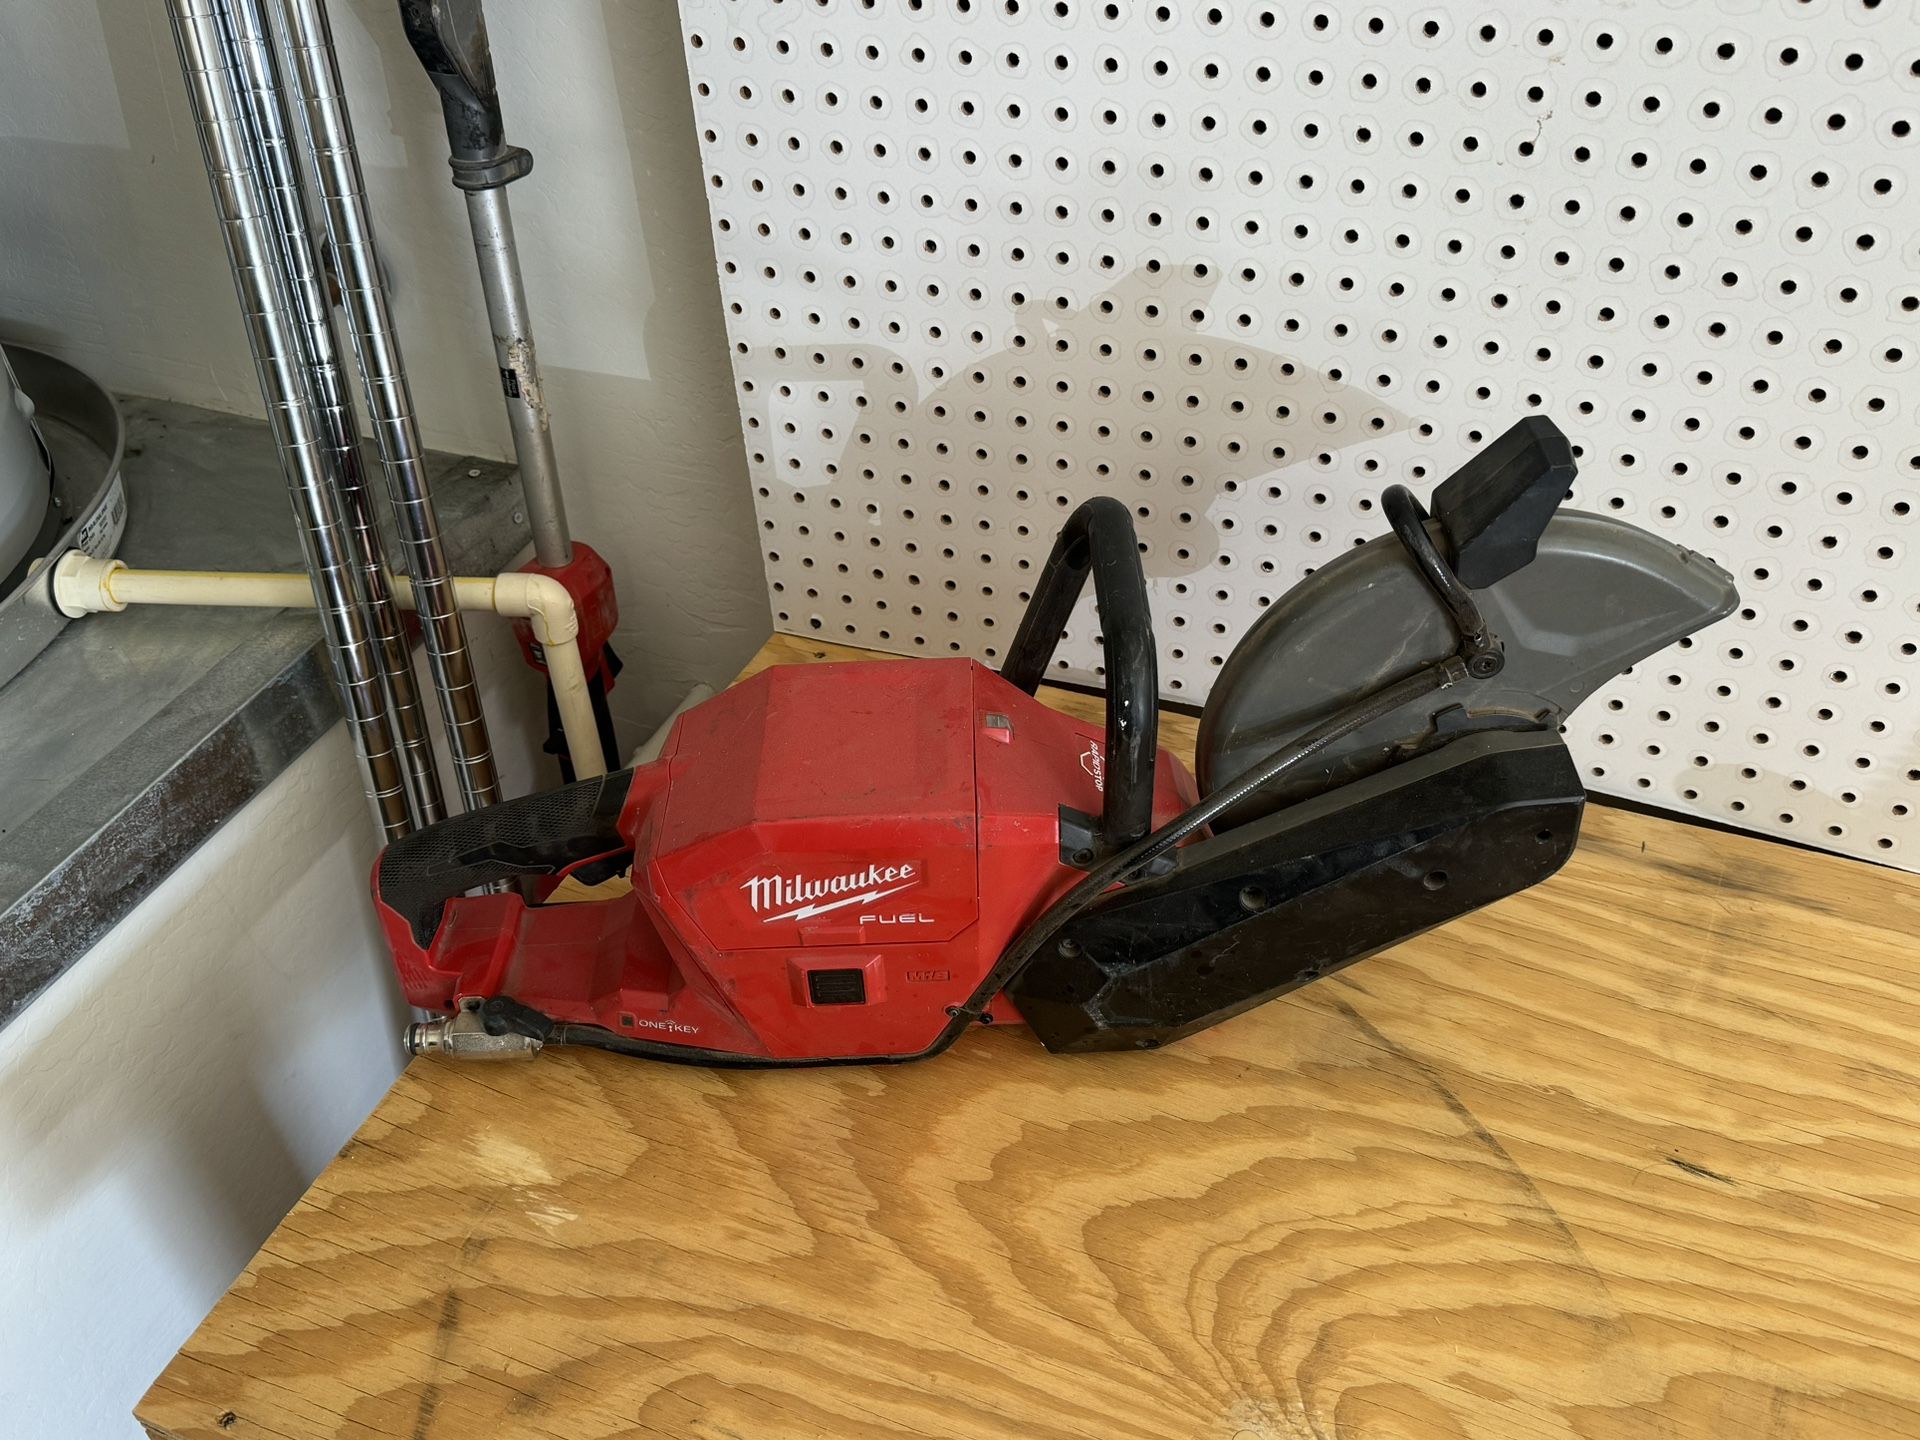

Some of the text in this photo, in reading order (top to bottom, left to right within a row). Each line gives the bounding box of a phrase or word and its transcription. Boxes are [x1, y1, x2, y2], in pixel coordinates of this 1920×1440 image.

[1089, 740, 1104, 792] RAPIDSTOP
[740, 864, 916, 912] Milwaukee
[859, 913, 935, 924] FUEL
